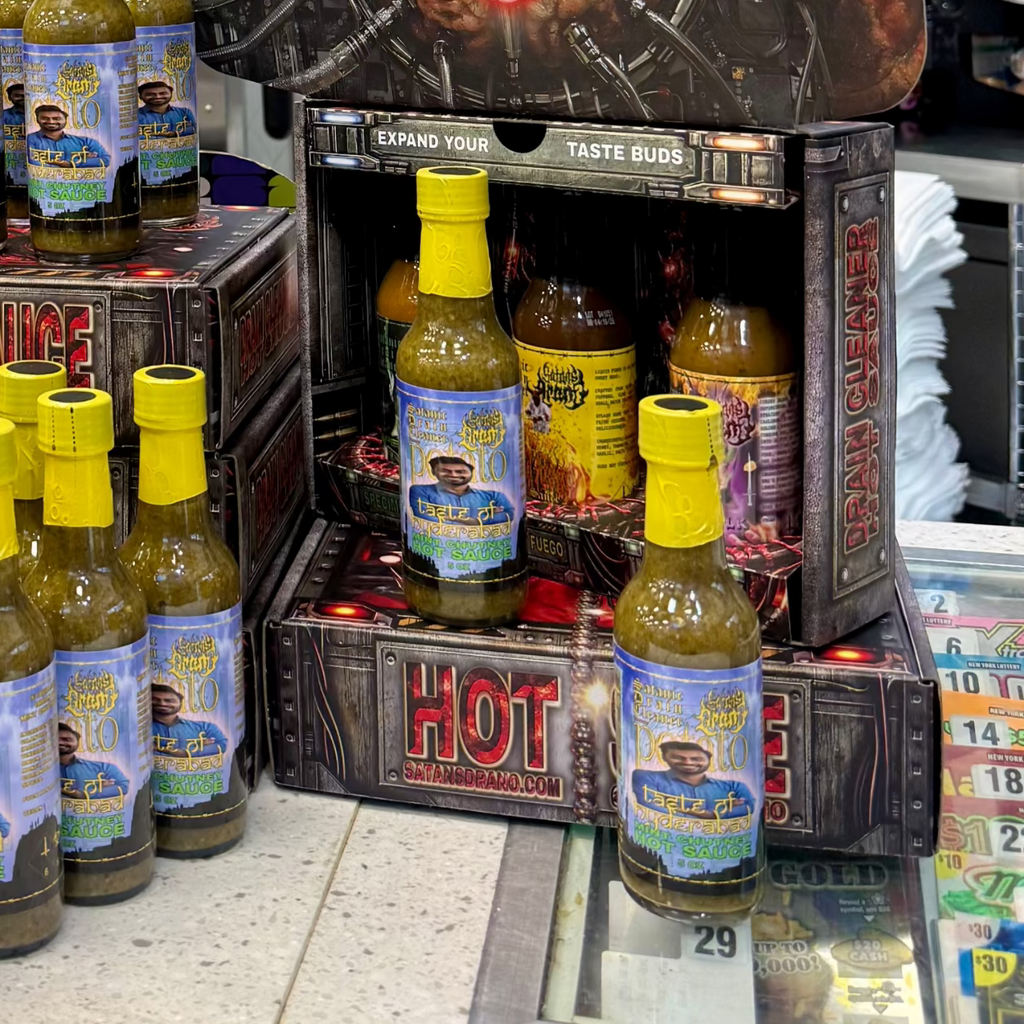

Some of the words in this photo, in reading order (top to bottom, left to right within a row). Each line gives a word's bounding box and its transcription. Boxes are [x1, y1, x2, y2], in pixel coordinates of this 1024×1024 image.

[376, 130, 439, 150] EXPAND
[444, 135, 489, 153] YOUR
[567, 141, 625, 162] TASTE
[631, 145, 683, 165] BUDS
[50, 189, 107, 201] SAUCE
[417, 498, 470, 521] taste
[476, 499, 497, 523] of
[412, 532, 441, 548] MINT
[445, 537, 512, 550] CHUTNEY
[413, 542, 445, 558] HOT
[451, 547, 513, 561] SAUCE
[530, 534, 564, 557] FUEGO
[930, 594, 948, 613] 2
[946, 637, 962, 655] 6
[945, 670, 980, 694] 10
[405, 662, 561, 770] HOT
[963, 720, 1001, 745] 14
[988, 753, 1004, 761] NEW
[159, 782, 223, 796] SAUCE
[403, 760, 560, 800] SATANSDRANO.COM
[984, 767, 1024, 794] 18
[642, 784, 706, 814] taste
[713, 791, 737, 815] of
[634, 821, 673, 841] MINT
[676, 831, 752, 847] CHUTNEY
[634, 831, 675, 854] HOT
[683, 843, 752, 860] SAUCE
[938, 854, 962, 870] $10
[770, 862, 888, 890] GOLD
[969, 922, 991, 938] $30
[694, 925, 738, 959] 29
[755, 942, 773, 954] UP
[781, 941, 807, 955] TO
[849, 951, 888, 963] CASH
[975, 954, 1007, 973] $30
